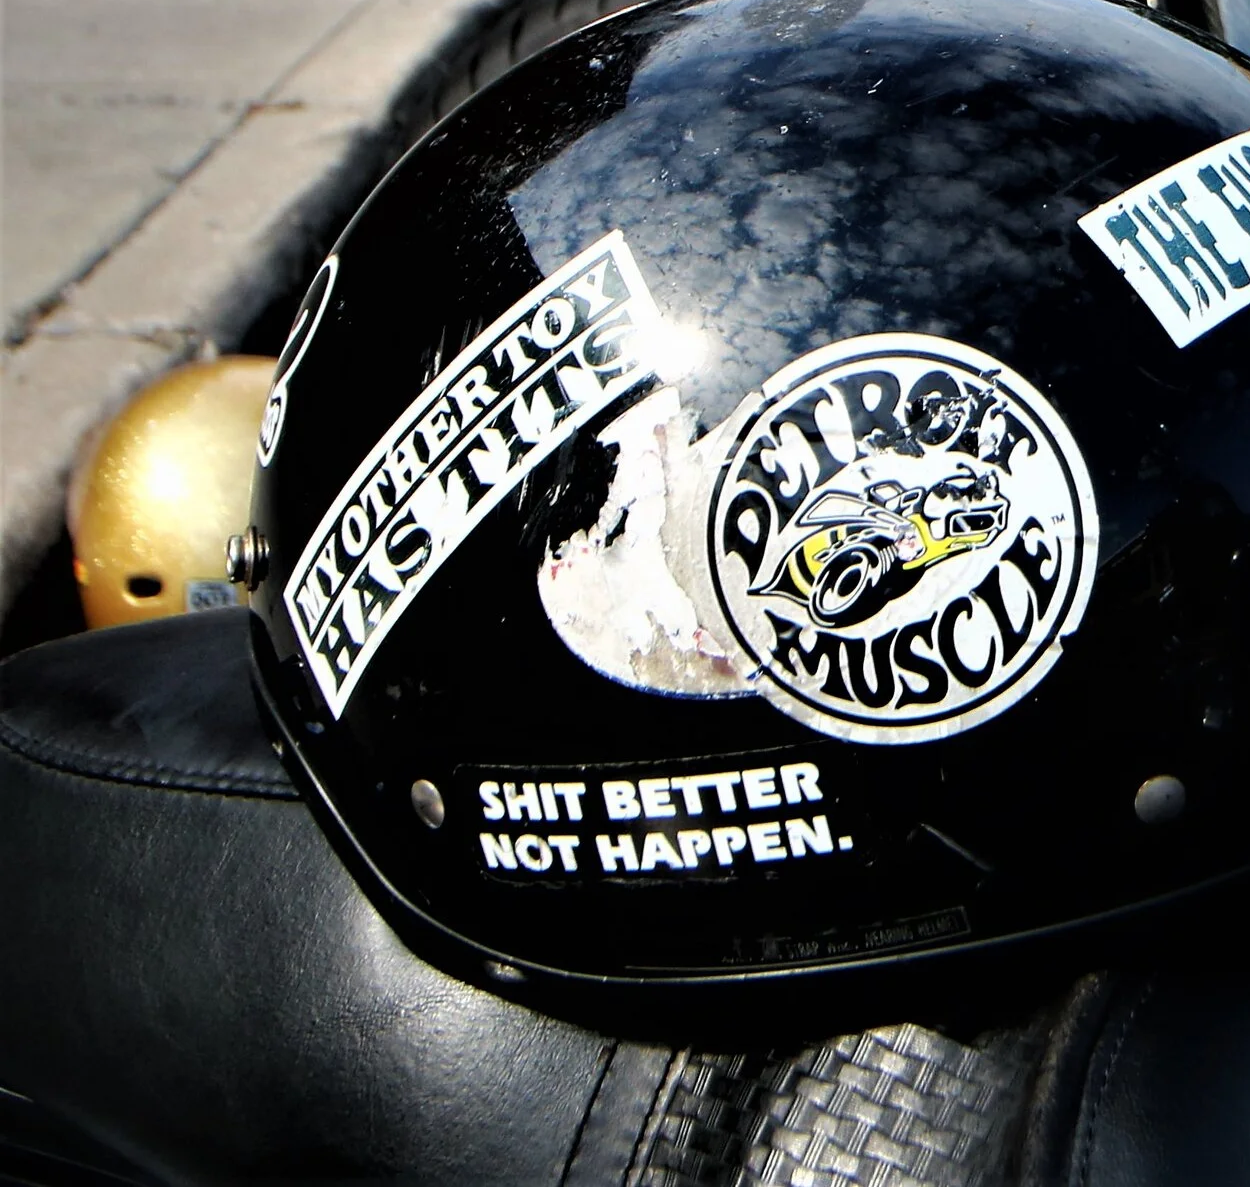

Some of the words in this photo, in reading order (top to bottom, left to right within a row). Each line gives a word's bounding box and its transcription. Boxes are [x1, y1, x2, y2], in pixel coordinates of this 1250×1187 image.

[341, 364, 500, 558] OTHER
[493, 257, 617, 381] TOY
[723, 370, 1039, 596] DETROIT
[312, 506, 434, 694] HAS
[764, 516, 1062, 710] MUSCLE
[479, 780, 586, 822] SHIT
[601, 761, 824, 822] BETTER
[479, 832, 580, 872] NOT
[595, 814, 854, 872] HAPPEN.
